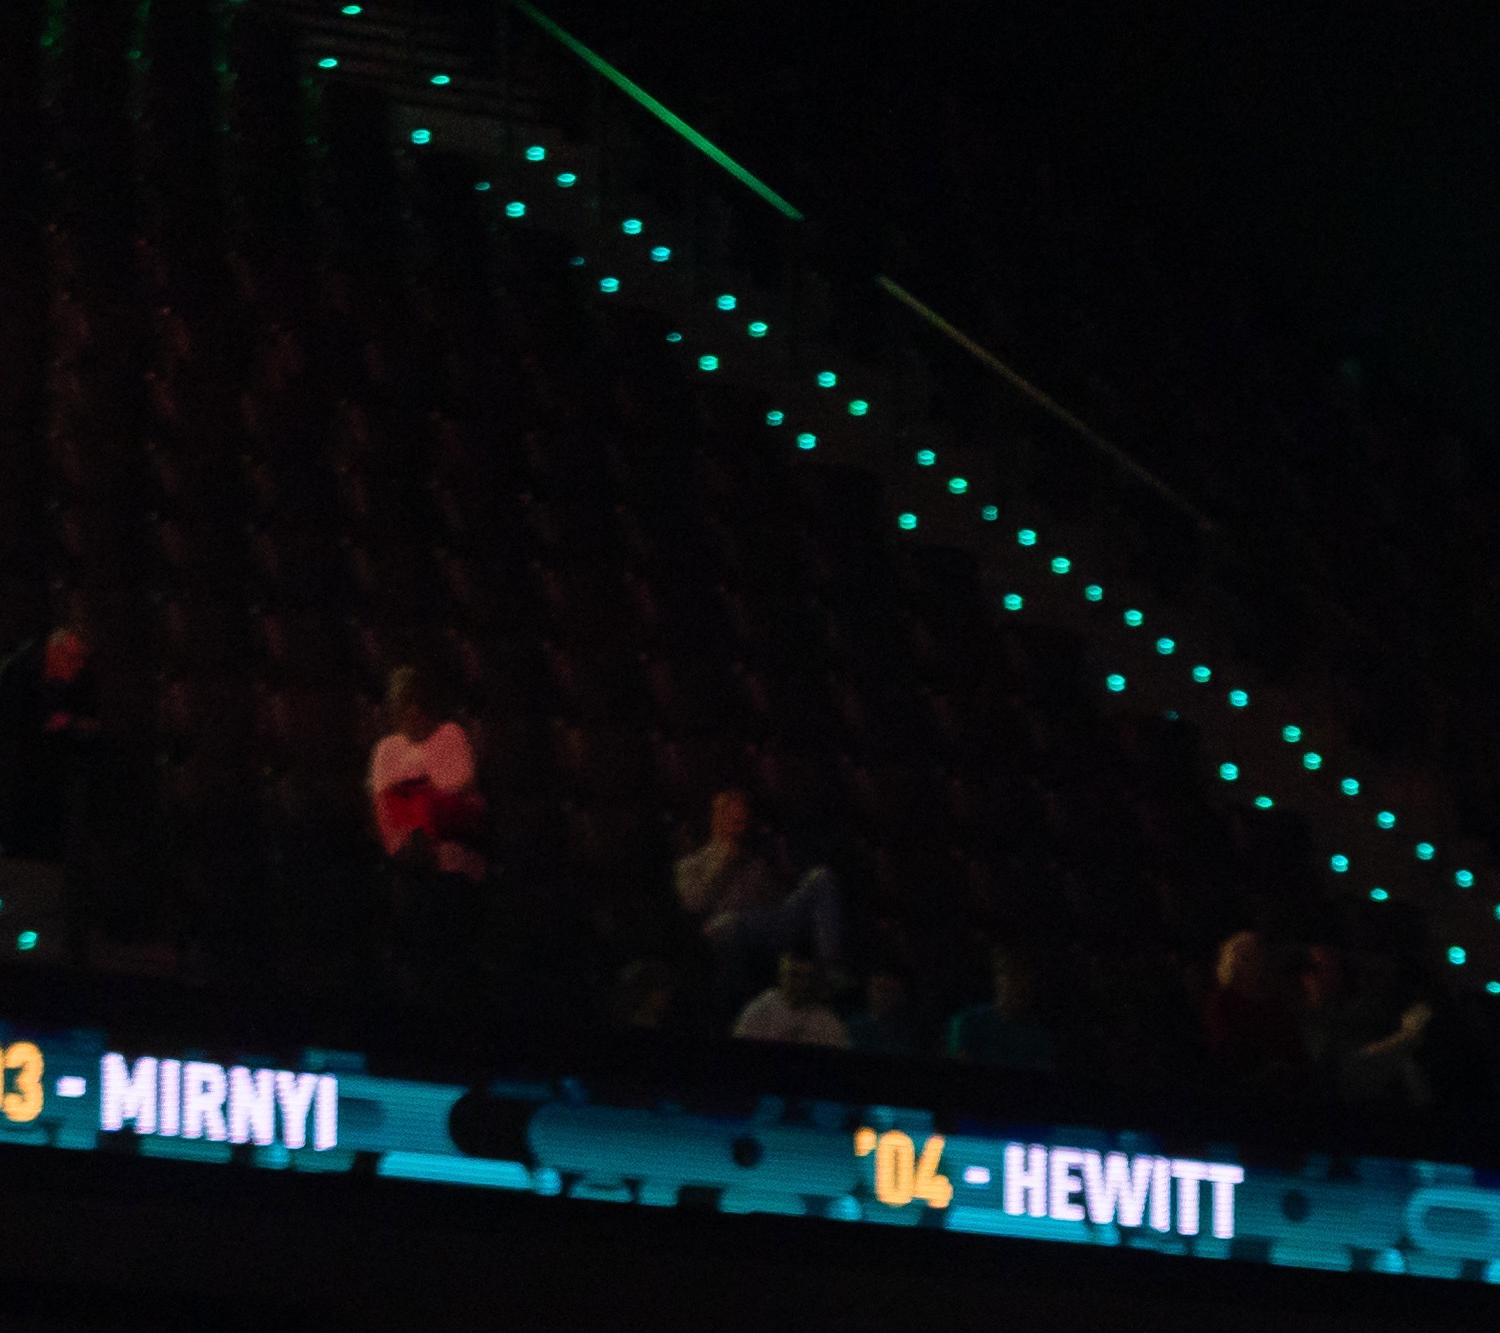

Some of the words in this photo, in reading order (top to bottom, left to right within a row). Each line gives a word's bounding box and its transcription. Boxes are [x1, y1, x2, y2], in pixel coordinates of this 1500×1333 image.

[99, 1051, 340, 1153] MIRNYI
[852, 1125, 955, 1210] '04
[1002, 1141, 1246, 1241] HEWITT
